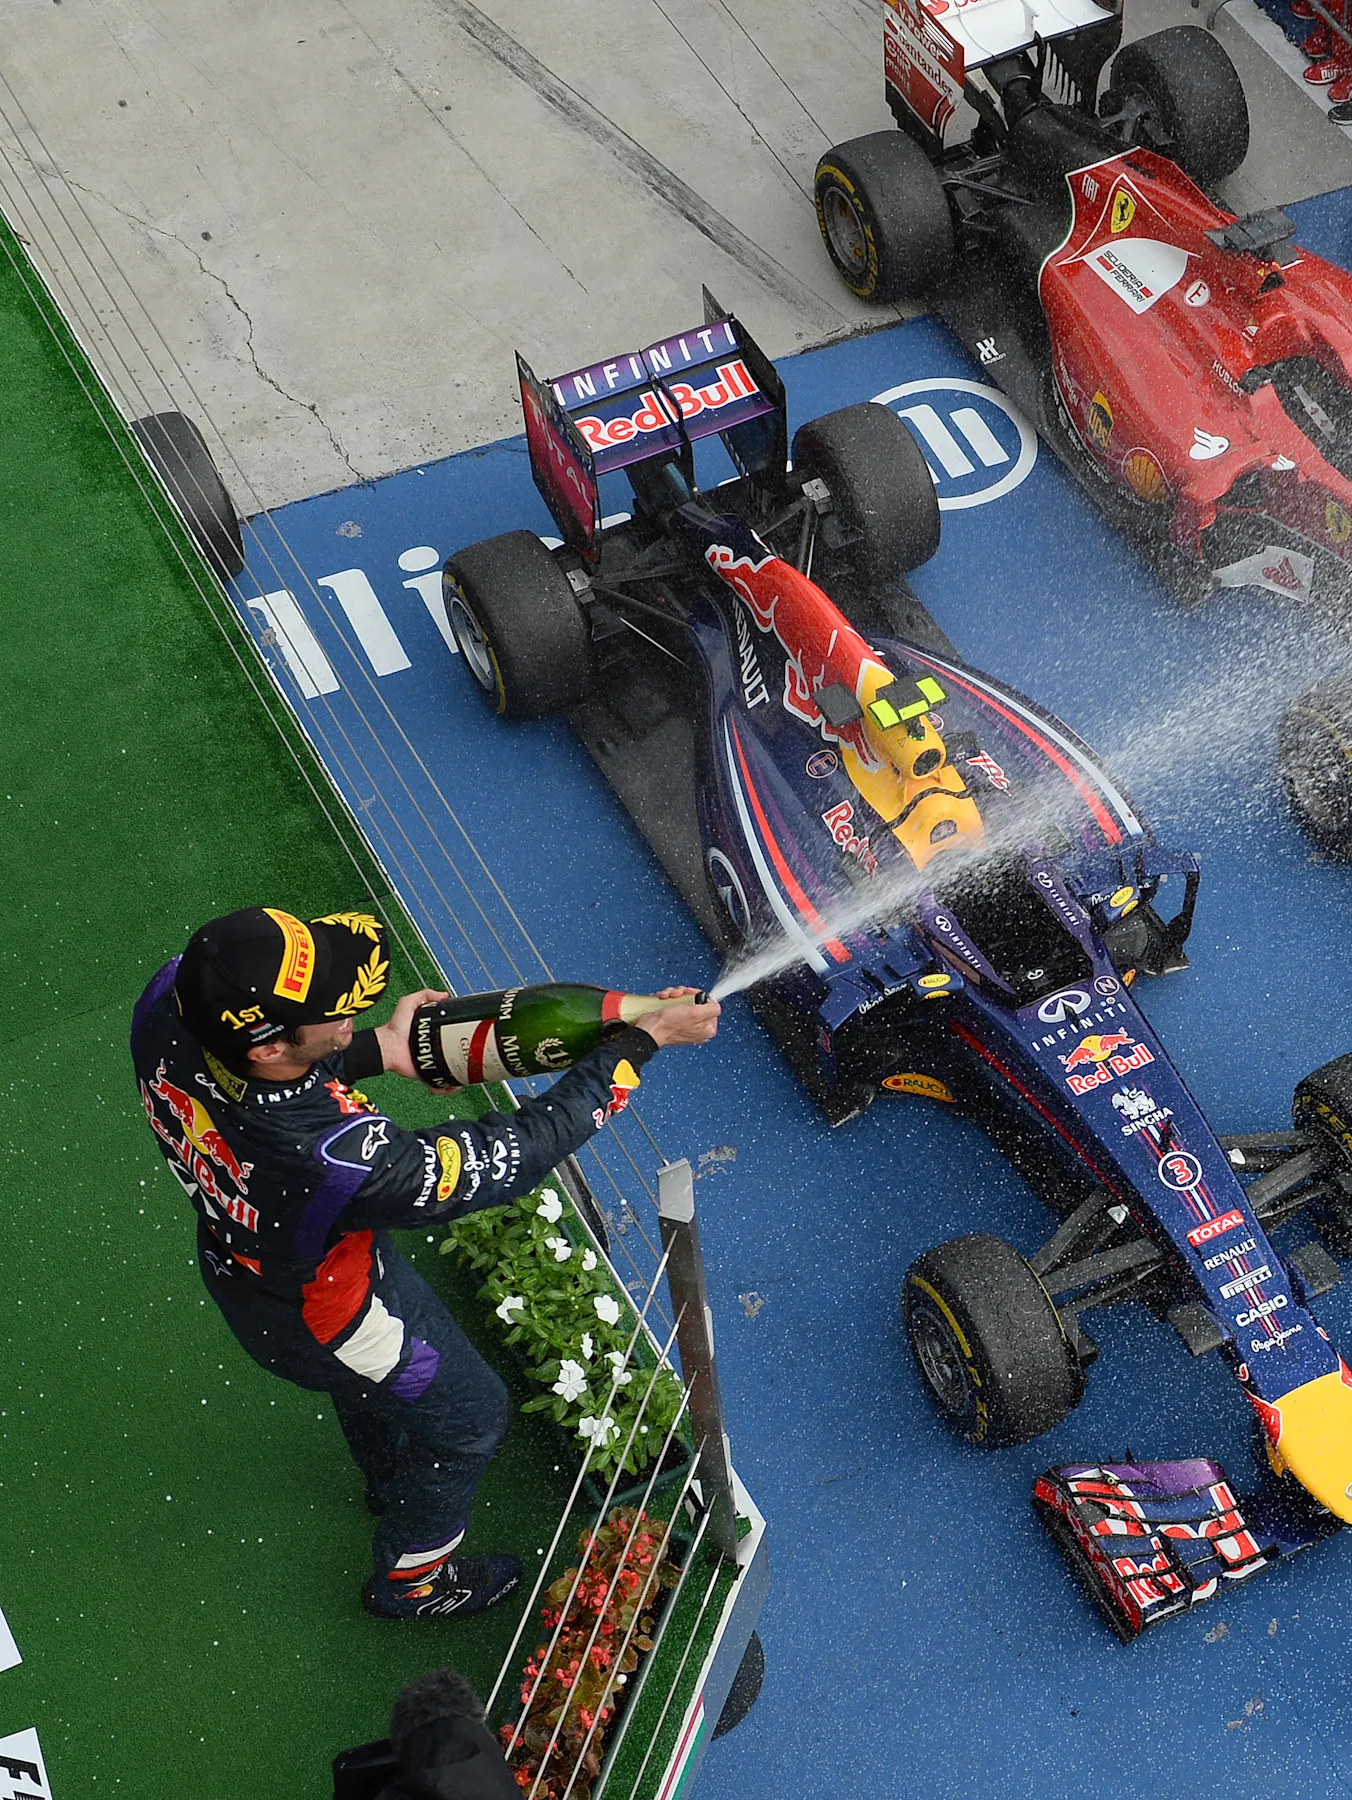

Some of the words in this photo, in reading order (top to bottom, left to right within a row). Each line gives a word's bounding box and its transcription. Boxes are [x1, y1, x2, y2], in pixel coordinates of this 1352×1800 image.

[1082, 174, 1100, 203] FIAT
[1103, 250, 1143, 290] SCUDERIA
[1110, 270, 1146, 303] FERRARI
[553, 323, 735, 406] INFINITI
[1211, 360, 1245, 398] HUBLOT
[574, 390, 669, 452] Red
[661, 359, 760, 420] Bull
[1050, 888, 1080, 926] INFINITI
[274, 912, 309, 993] PIRELLI
[949, 932, 981, 969] INFINITI
[221, 1005, 265, 1030] 1ST
[1032, 1002, 1127, 1052] INFINITI
[417, 1017, 437, 1070] MUMM
[903, 1078, 949, 1096] RAUCH
[1065, 1063, 1114, 1096] Red
[1110, 1043, 1155, 1076] Bull
[1121, 1107, 1174, 1137] SINGHA
[1167, 1159, 1193, 1184] 3
[1188, 1214, 1245, 1244] TOTAL
[1203, 1238, 1257, 1271] RENAULT
[1219, 1265, 1273, 1300] PIRELLI
[1235, 1294, 1288, 1327] CASIO
